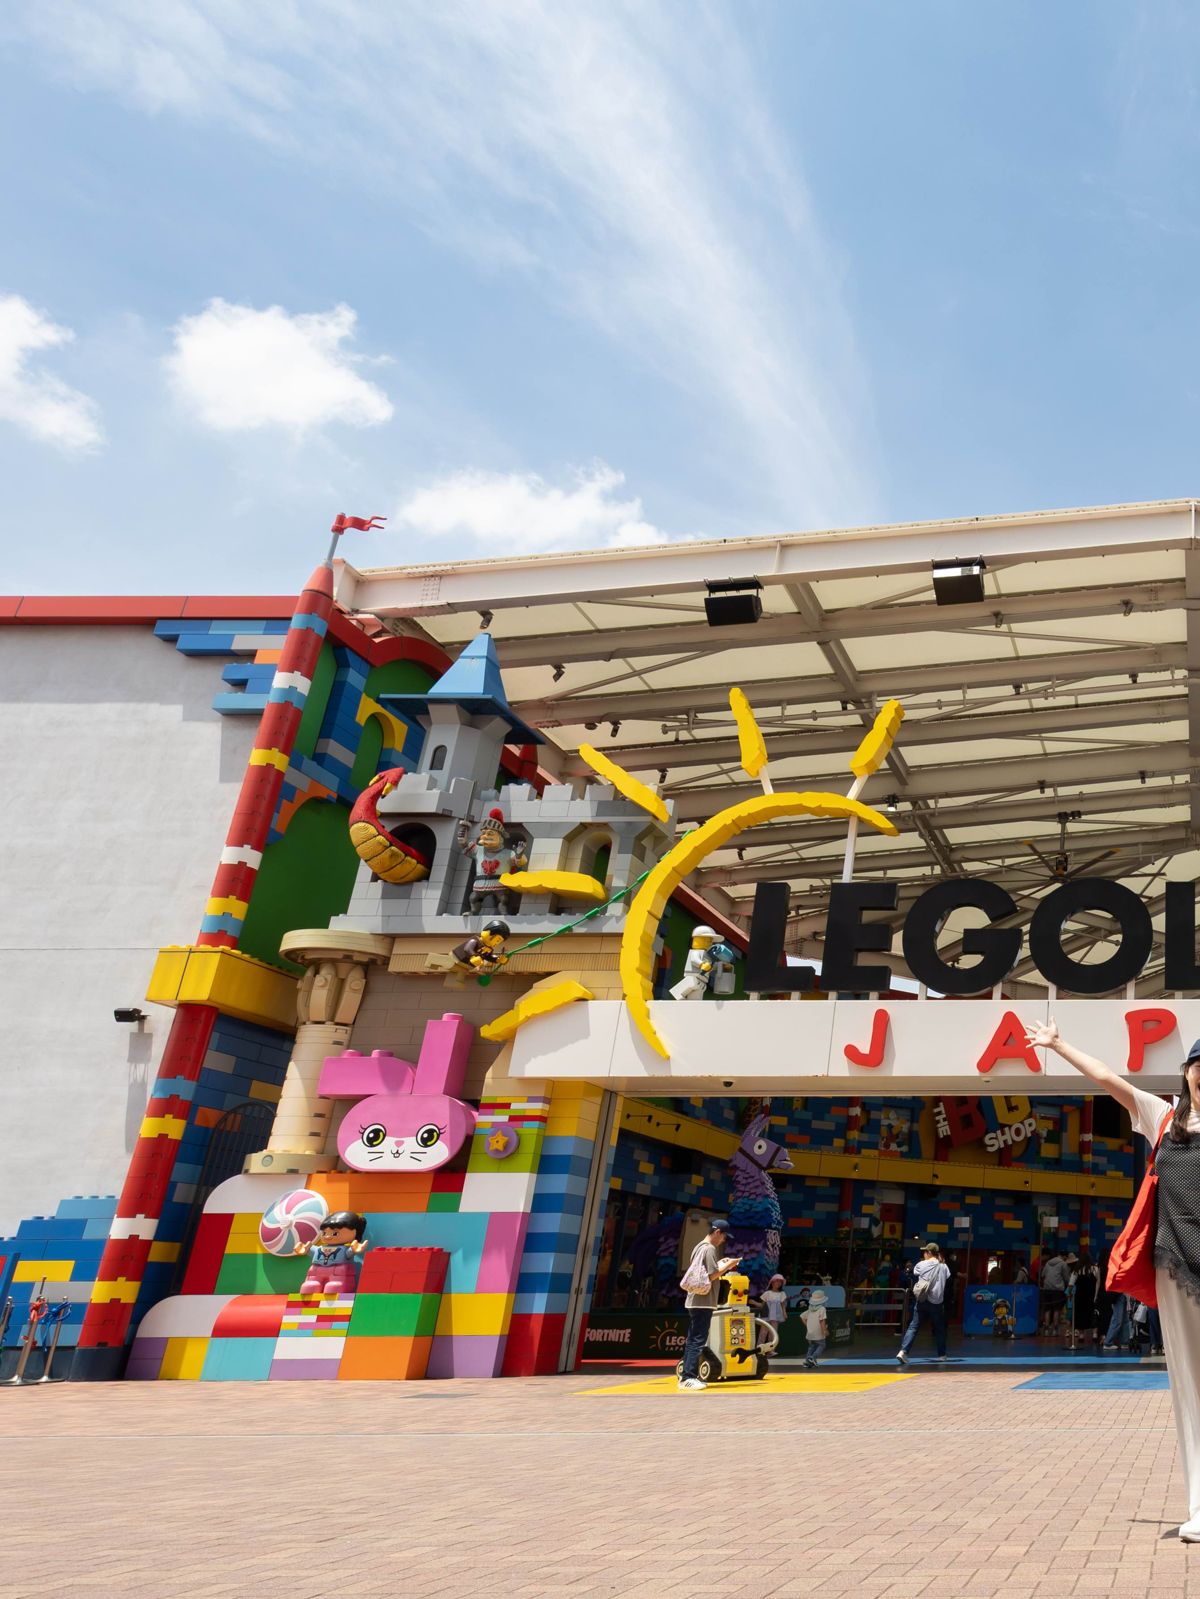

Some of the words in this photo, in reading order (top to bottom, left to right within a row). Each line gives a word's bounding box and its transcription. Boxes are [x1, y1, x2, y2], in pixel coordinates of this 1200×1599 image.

[933, 1102, 951, 1138] THE
[984, 1118, 1037, 1152] SHOP
[584, 1327, 631, 1343] FORTNITE
